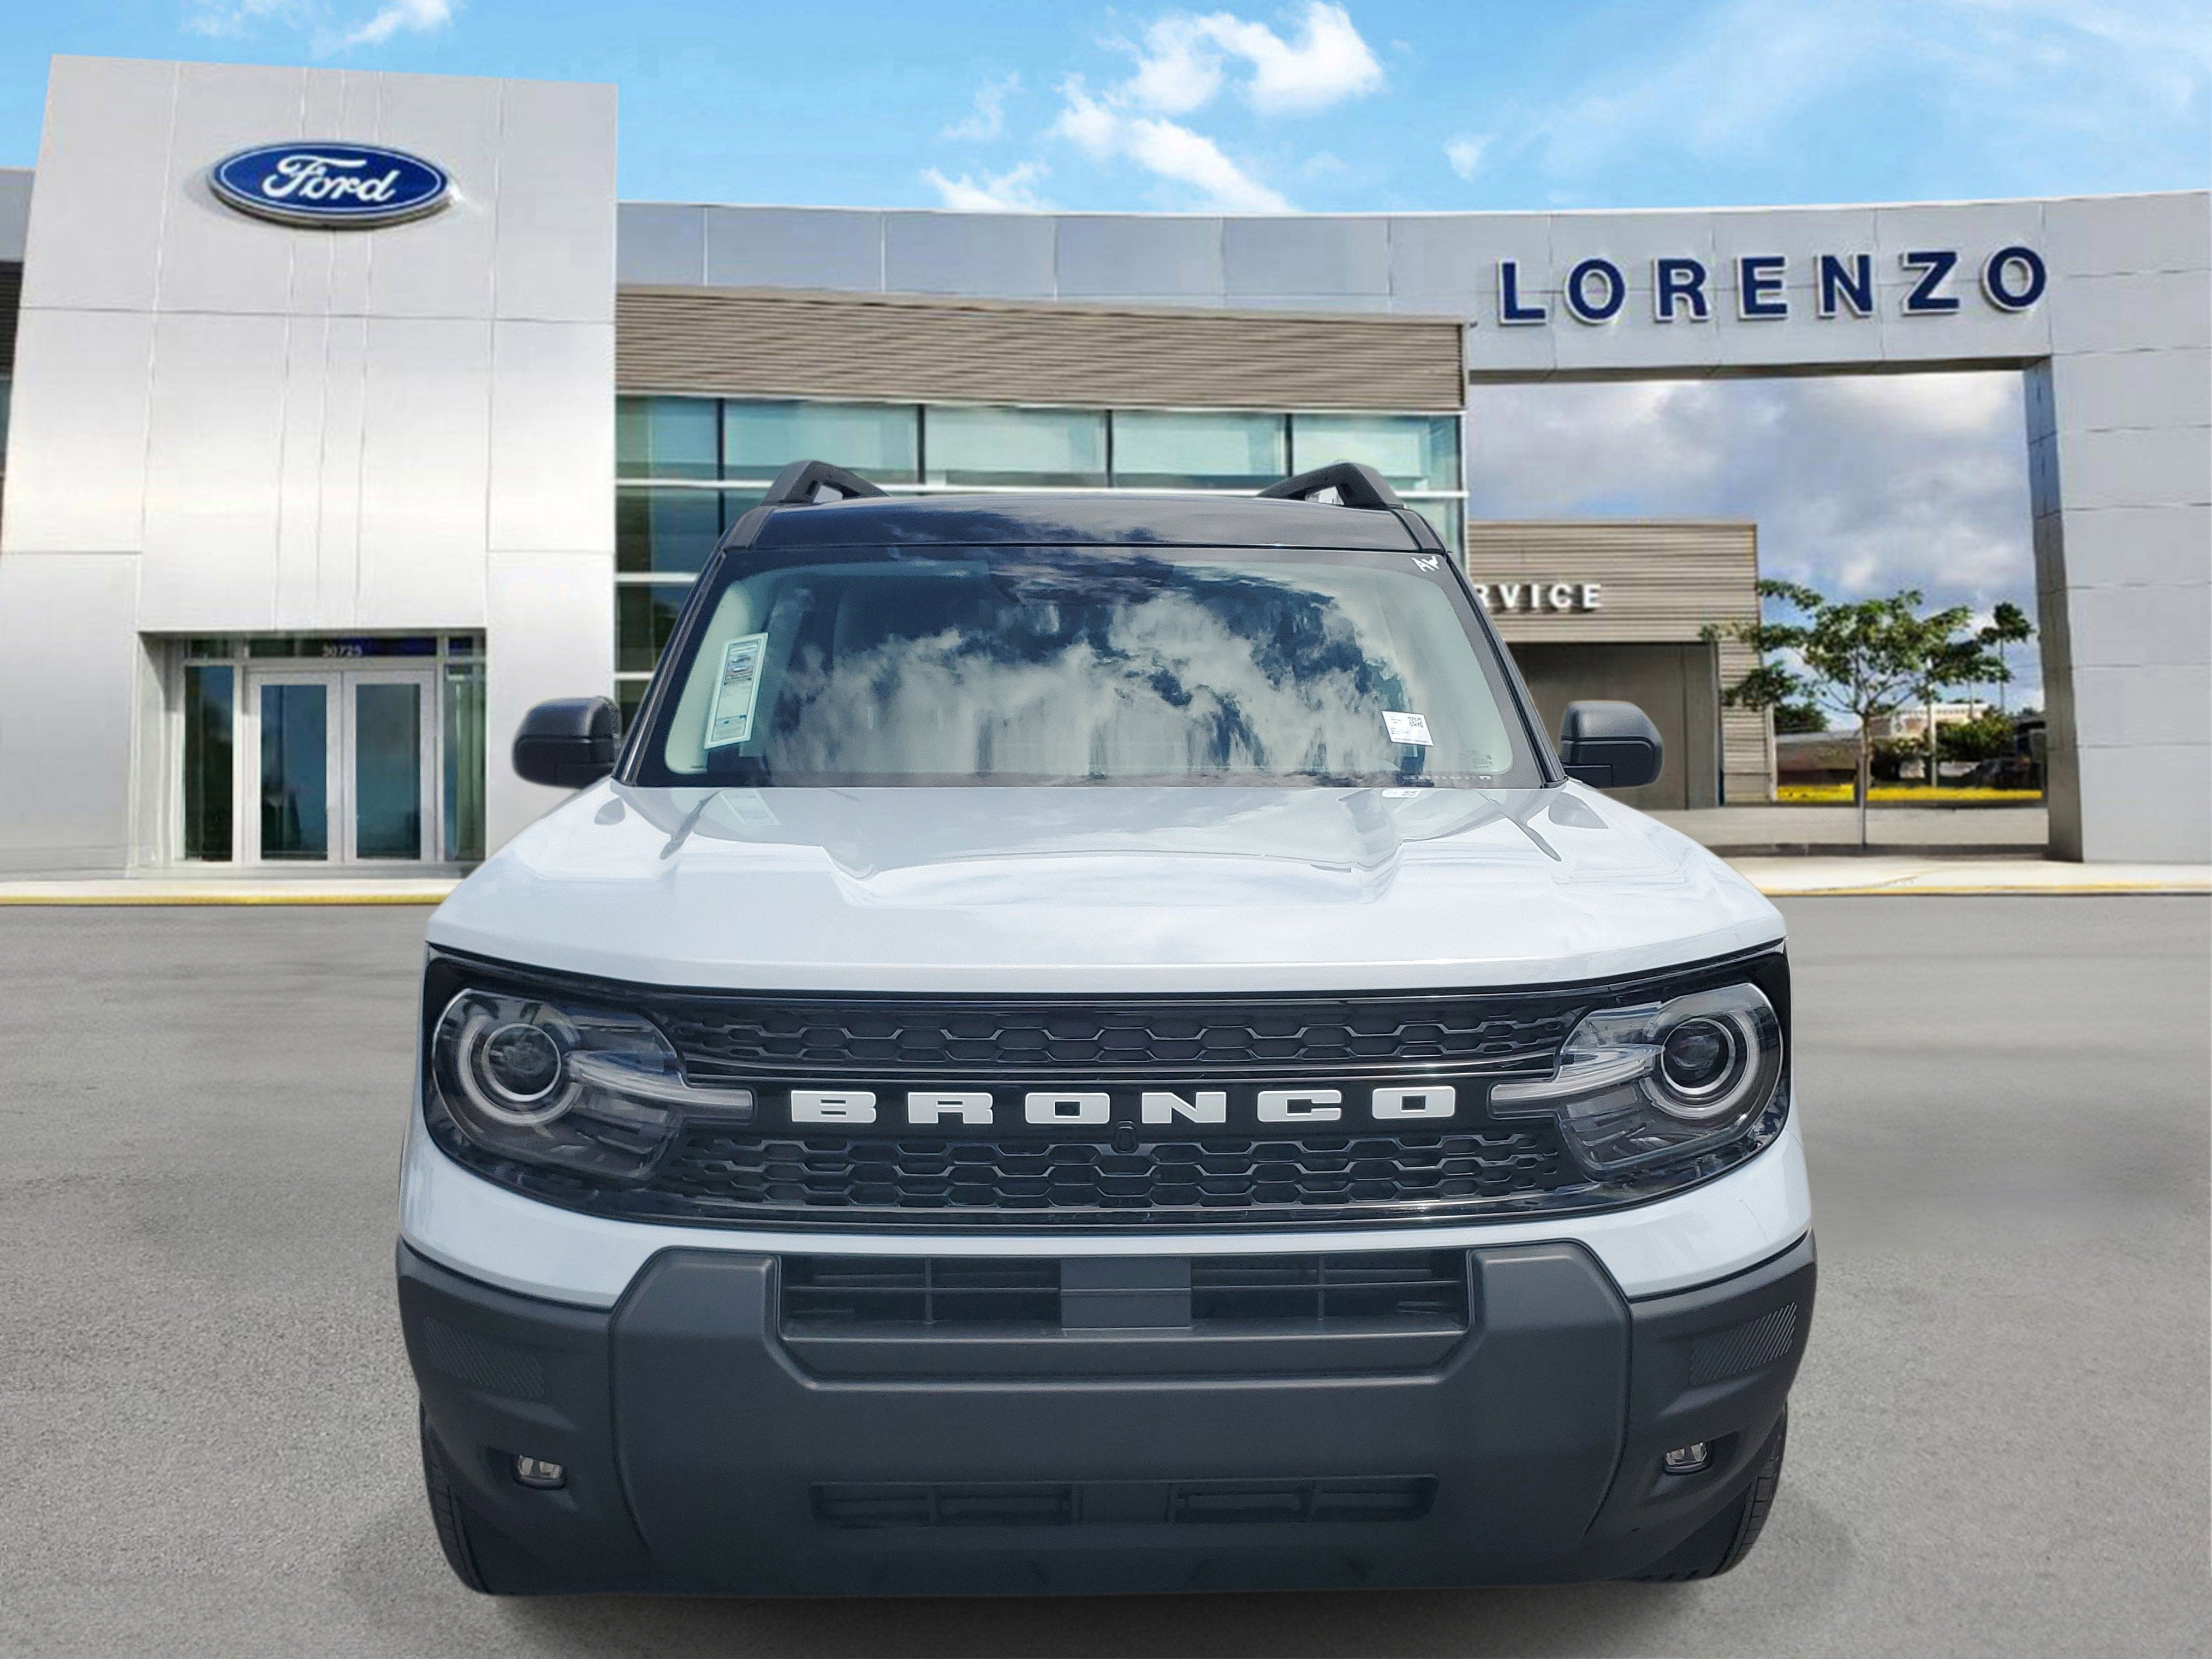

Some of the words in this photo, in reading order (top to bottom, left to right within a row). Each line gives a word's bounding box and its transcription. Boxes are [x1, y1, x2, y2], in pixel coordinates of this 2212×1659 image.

[263, 154, 401, 201] Ford
[1498, 247, 2047, 325] LORENZO
[1473, 583, 1602, 609] RVICE
[790, 1085, 1456, 1124] BRONCO
